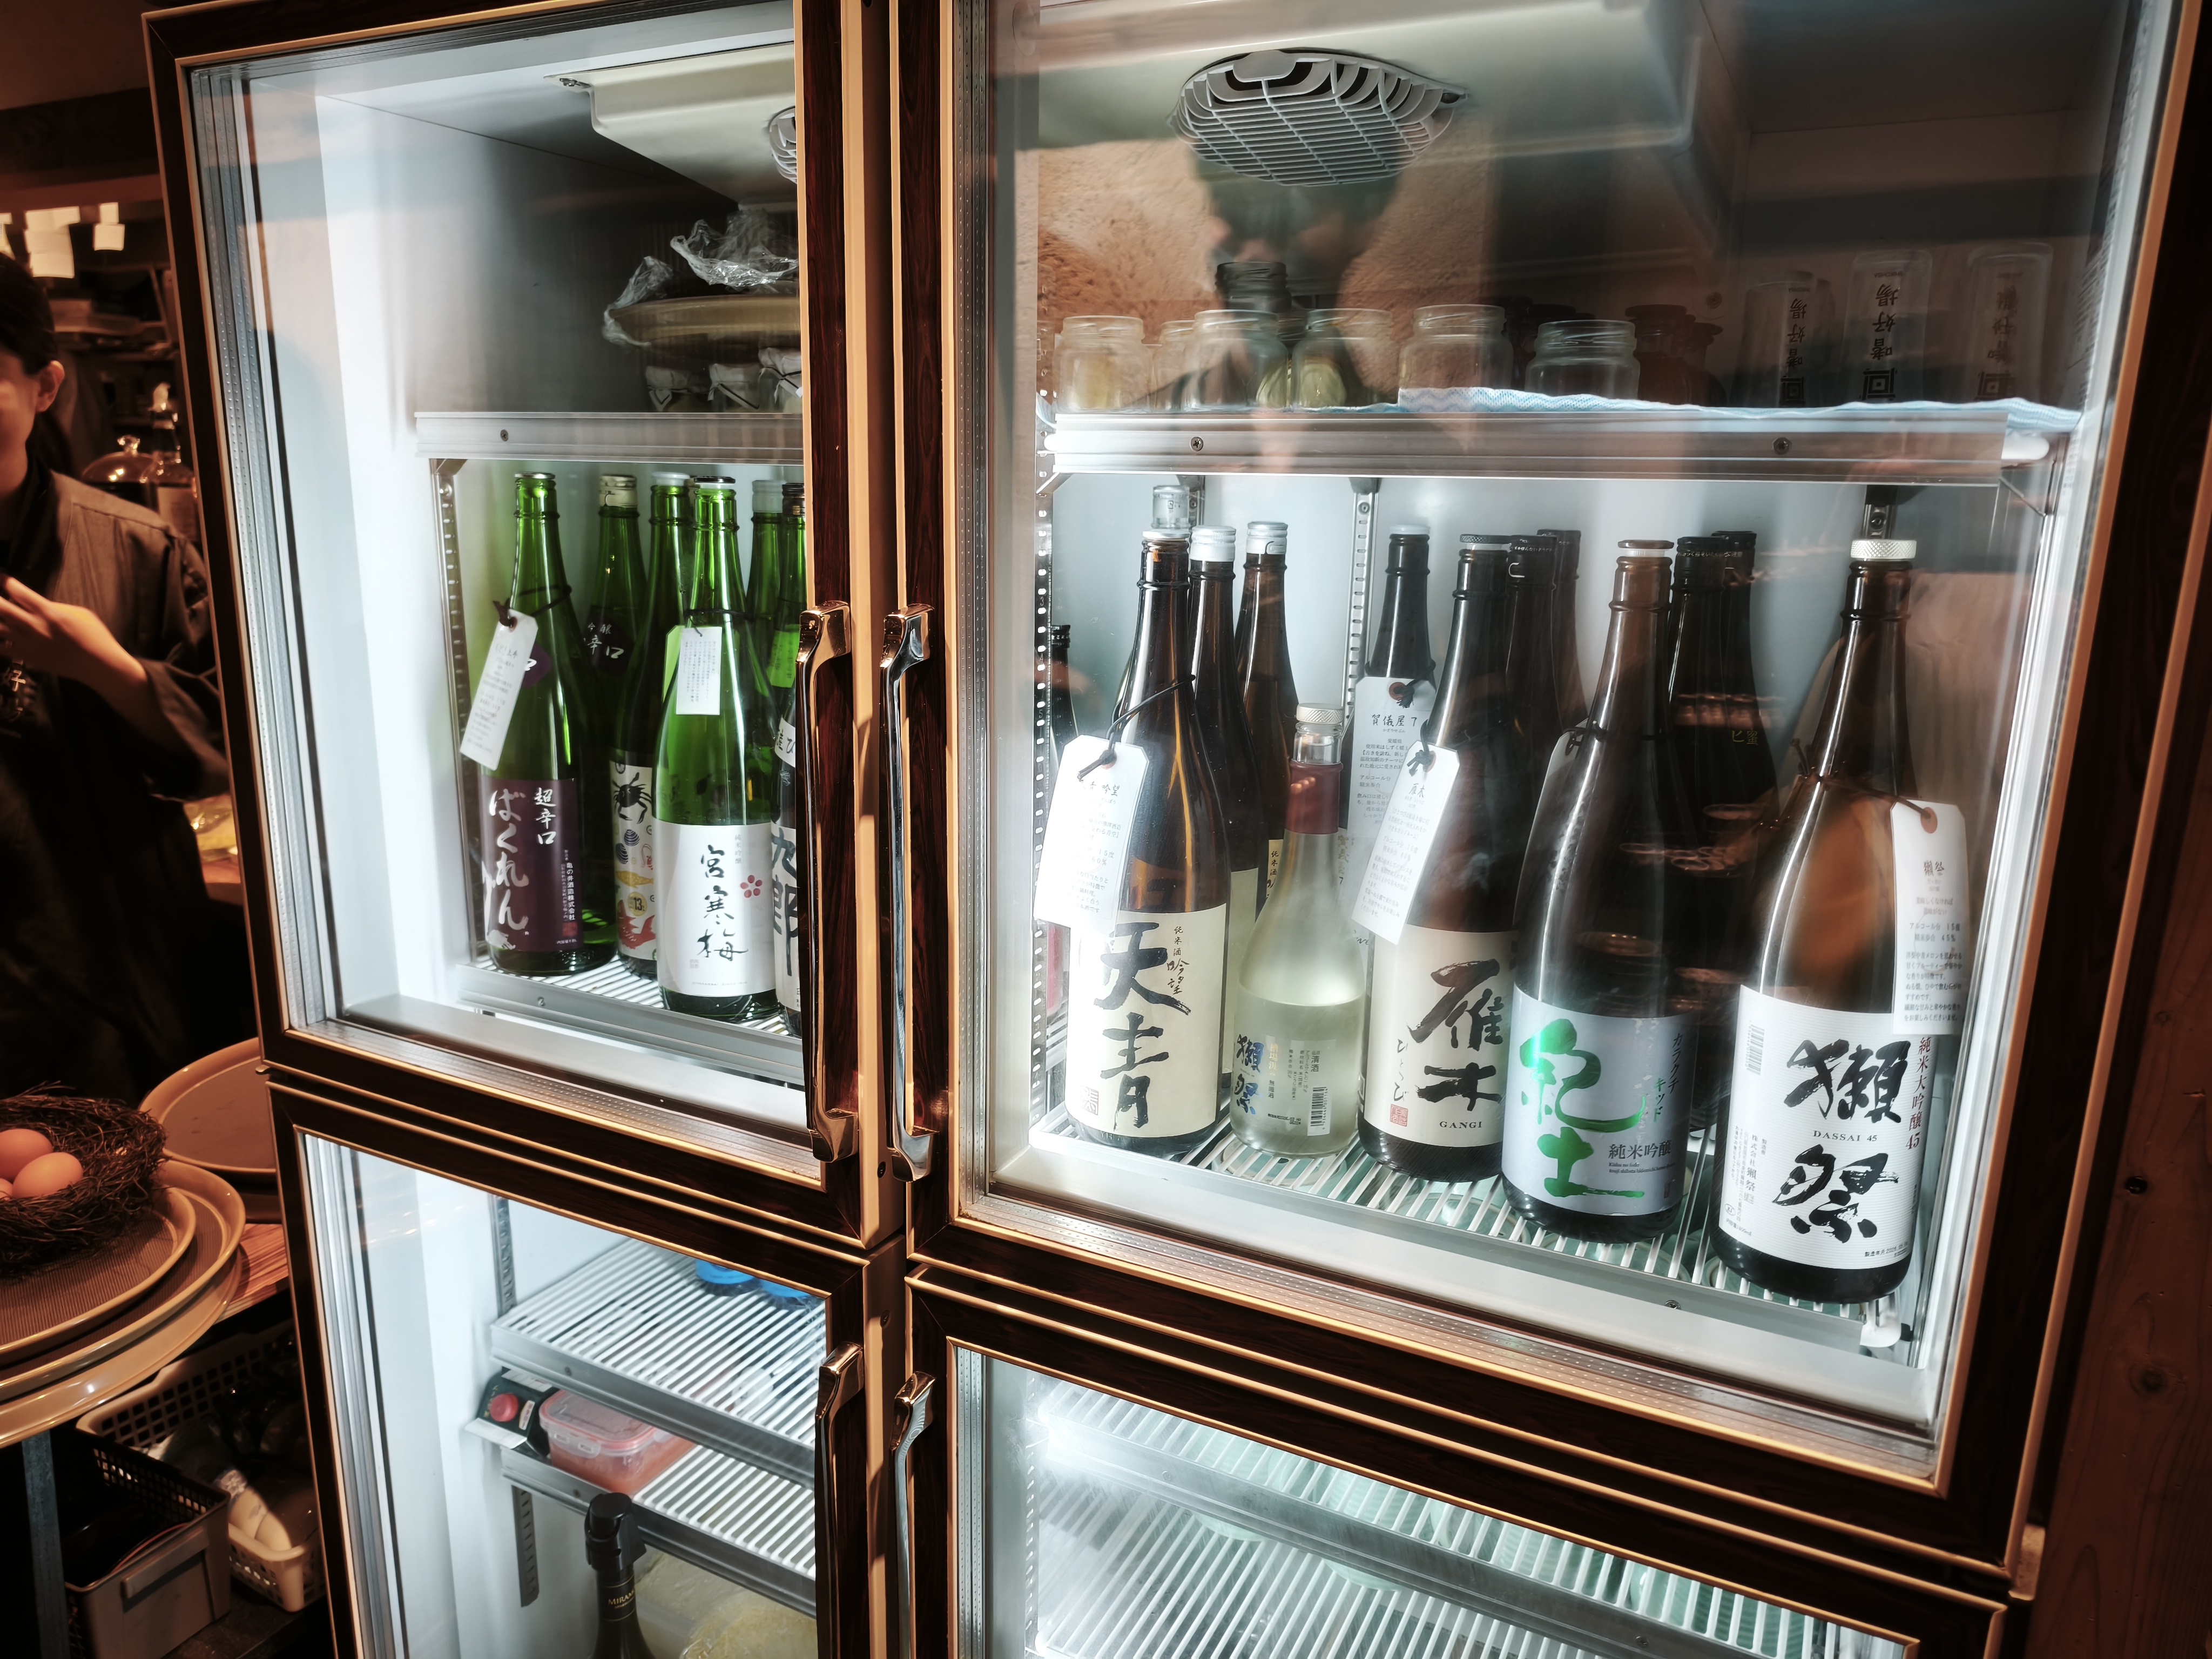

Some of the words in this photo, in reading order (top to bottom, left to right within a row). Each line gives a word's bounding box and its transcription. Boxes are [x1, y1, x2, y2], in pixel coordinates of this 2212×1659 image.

[1787, 298, 1808, 368] 嗜好場
[1870, 284, 1899, 361] 嗜好場
[583, 635, 624, 658] 辛口
[1372, 714, 1405, 727] 賀儀屋
[1411, 717, 1417, 726] 7
[534, 787, 557, 845] 超辛口
[489, 788, 530, 930] ばくれん
[1271, 851, 1279, 875] 純米酒
[697, 844, 749, 962] 宮寒梅
[1173, 925, 1183, 957] 純米酒
[1094, 922, 1191, 1132] 天青
[1406, 959, 1505, 1111] 雁木
[1311, 1055, 1320, 1072] 清酒
[1668, 1032, 1683, 1094] カラクチ
[1439, 1121, 1482, 1129] GANGI
[1520, 1019, 1646, 1198] 紀土
[1654, 1078, 1666, 1123] キッド
[1608, 1139, 1672, 1159] 純米吟醸
[1772, 1038, 1912, 1244] 獺祭
[1812, 1130, 1861, 1142] DASSAI
[1866, 1134, 1878, 1142] 45
